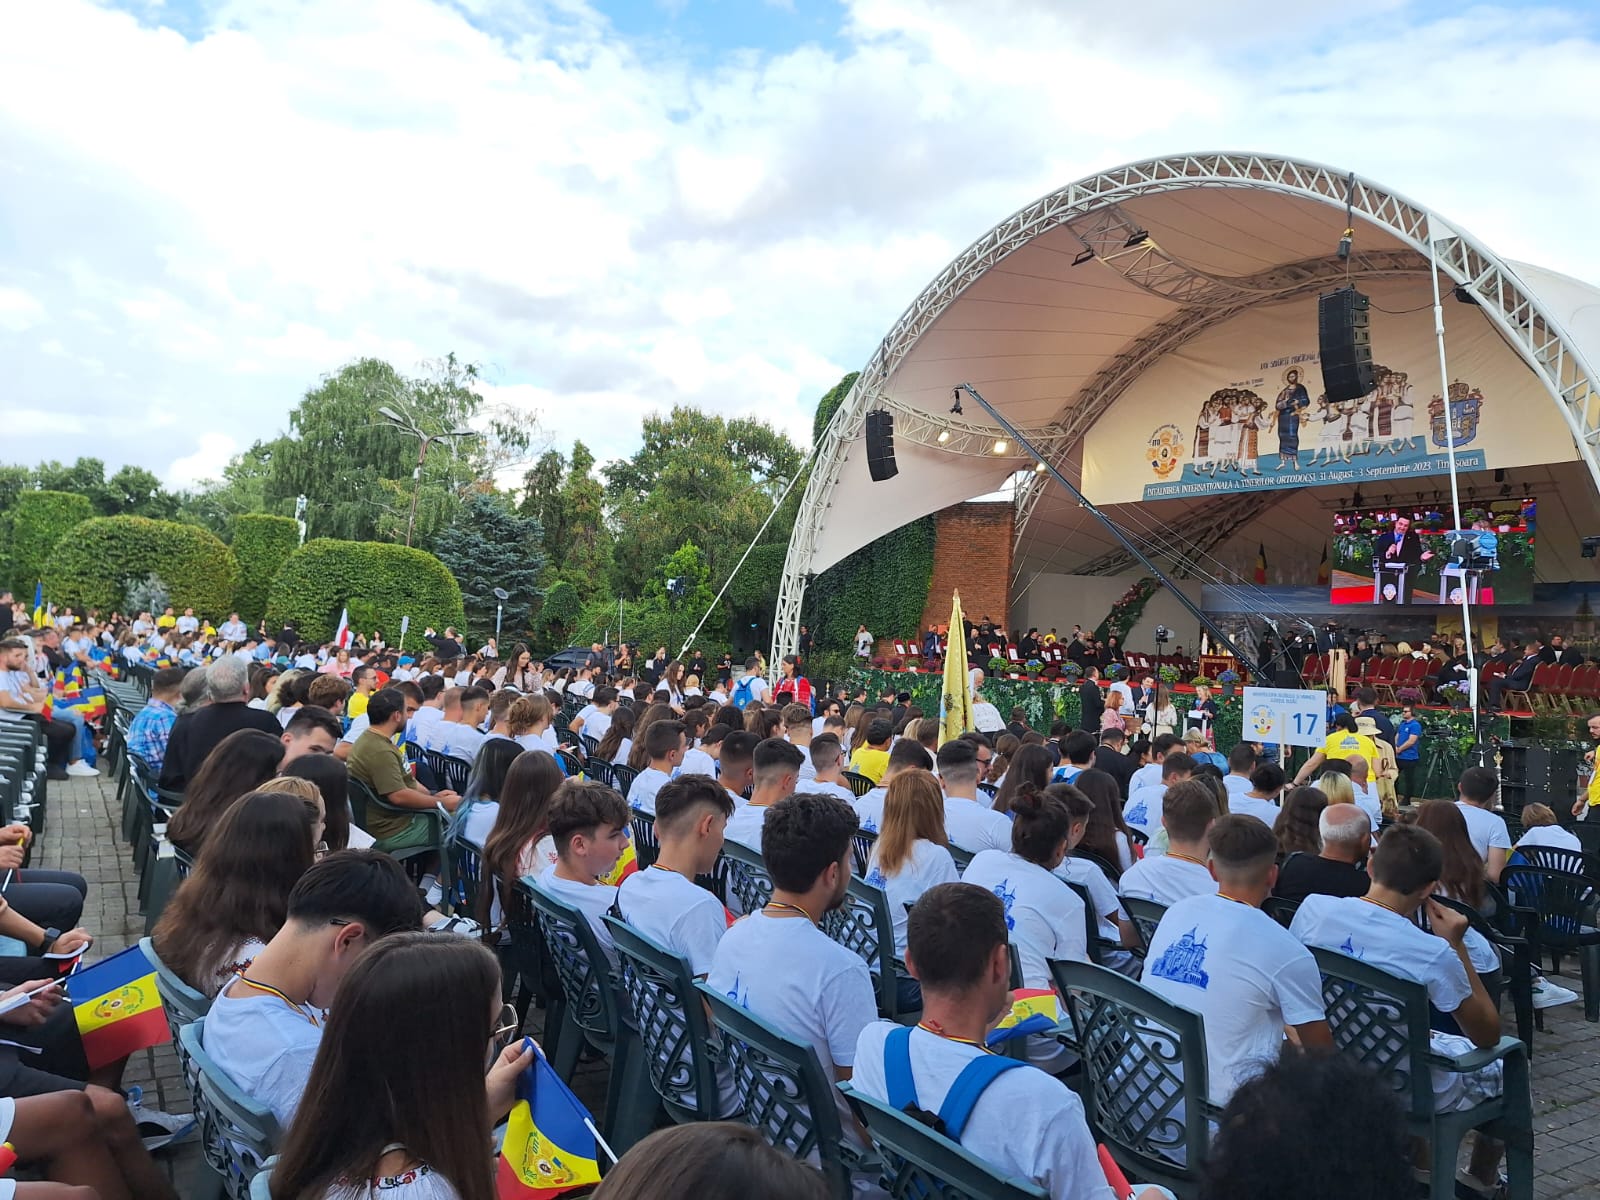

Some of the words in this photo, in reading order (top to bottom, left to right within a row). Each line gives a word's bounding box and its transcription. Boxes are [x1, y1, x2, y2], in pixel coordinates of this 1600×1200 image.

[1319, 471, 1326, 481] 31
[1328, 470, 1354, 481] August
[1366, 463, 1410, 477] Septembrie
[1292, 712, 1318, 736] 17
